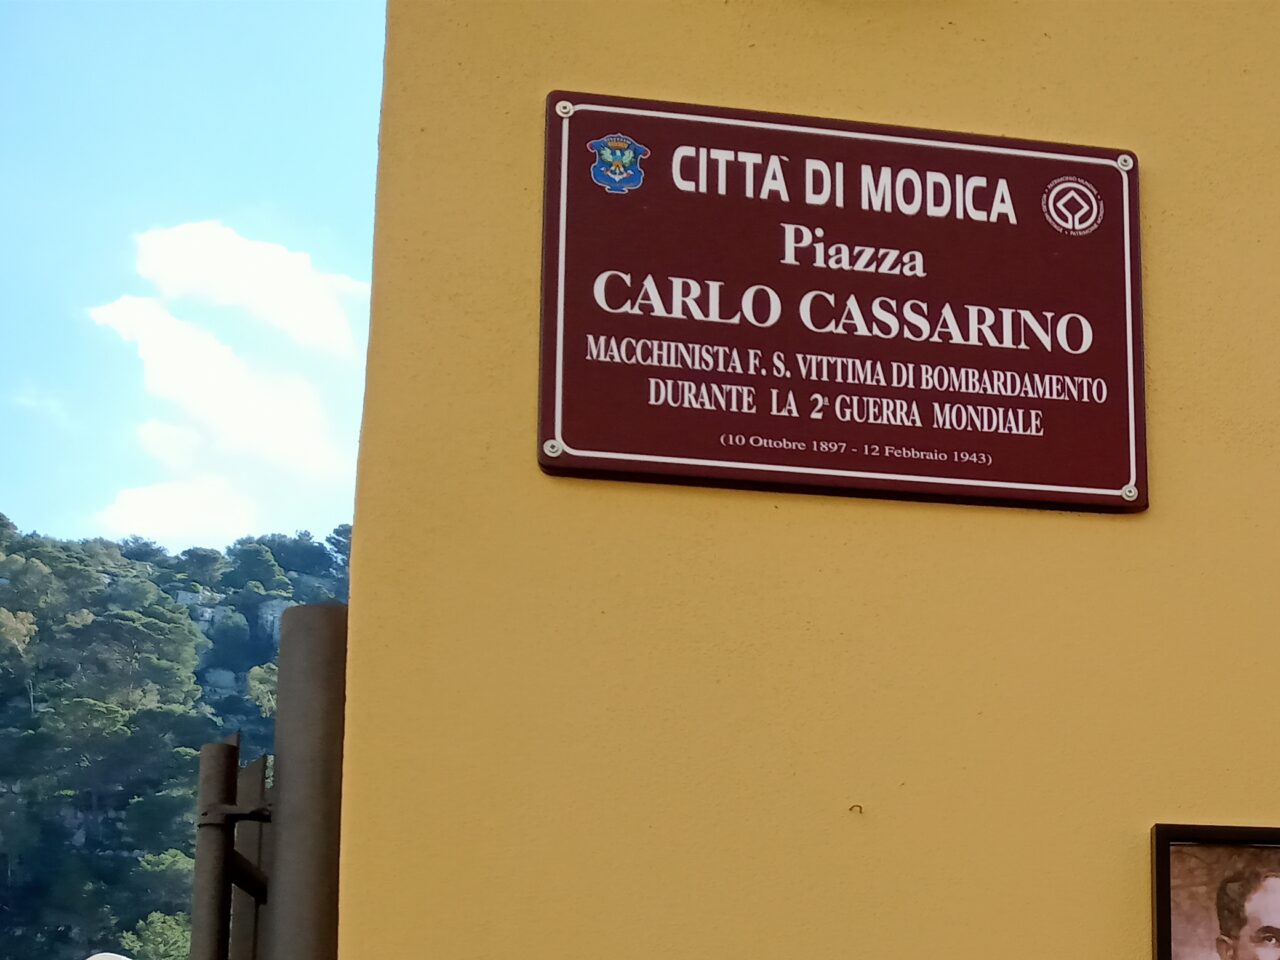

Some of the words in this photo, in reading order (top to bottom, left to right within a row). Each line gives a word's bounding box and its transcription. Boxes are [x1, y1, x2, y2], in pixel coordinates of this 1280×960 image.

[672, 146, 789, 201] CITTÀ
[806, 159, 843, 207] DI
[861, 165, 1017, 224] MODICA
[781, 223, 926, 277] Piazza
[594, 271, 781, 327] CARLO
[799, 291, 1092, 354] CASSARINO
[586, 335, 743, 373] MACCHINISTA
[748, 349, 766, 376] F.
[773, 352, 791, 377] S.
[796, 354, 887, 386] VITTIMA
[891, 362, 914, 388] DI
[920, 365, 1107, 403] BOMBARDAMENTO
[649, 378, 756, 413] DURANTE
[771, 389, 799, 417] LA
[835, 395, 922, 427] GUERRA
[933, 404, 1043, 436] MONDIALE
[720, 434, 745, 445] (10
[750, 436, 806, 450] Ottobre
[813, 441, 846, 453] 1897
[865, 445, 879, 455] 12
[885, 446, 947, 460] Febbraio
[954, 452, 992, 465] 1943)
